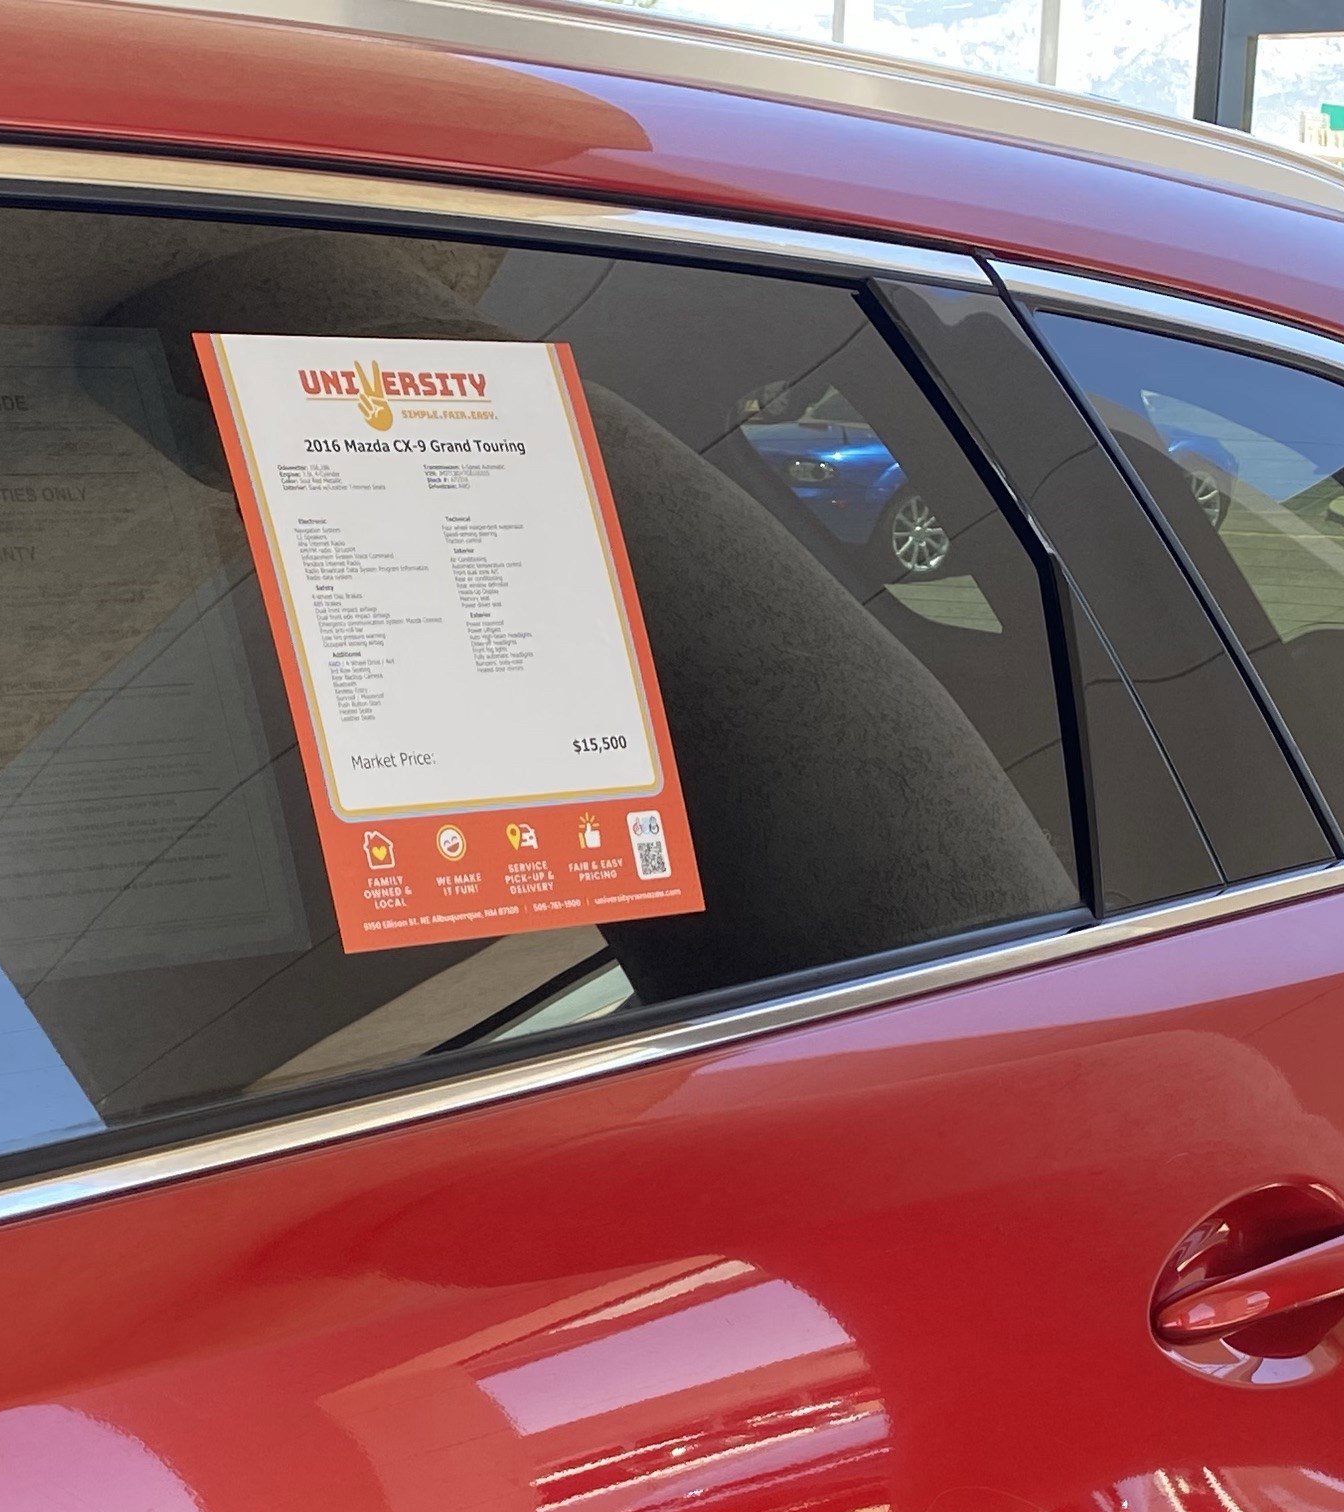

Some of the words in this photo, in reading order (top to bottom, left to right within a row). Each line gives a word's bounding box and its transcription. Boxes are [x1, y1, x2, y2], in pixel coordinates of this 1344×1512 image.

[298, 360, 487, 398] UNIVERSITY
[401, 410, 499, 421] SIMPLE.FAIR.EASY.
[304, 439, 341, 453] 2016
[344, 439, 390, 453] Mazda
[393, 439, 426, 453] CX-9
[430, 439, 471, 453] Grand
[473, 438, 526, 455] Touring
[41, 486, 88, 503] ONLY
[572, 735, 628, 754] $15,500
[350, 753, 397, 770] Market
[400, 752, 436, 767] Price:
[508, 860, 548, 873] SERVICE
[568, 861, 589, 873] FAIR
[600, 858, 623, 869] EASY
[368, 875, 403, 888] FAMILY
[436, 876, 452, 887] WE
[454, 872, 482, 884] MAKE
[505, 871, 545, 884] PICK-UP
[579, 870, 618, 882] PRICING
[363, 887, 402, 899] OWNED
[443, 886, 452, 896] IT
[455, 884, 479, 895] FUN!
[509, 882, 554, 894] DELIVERY
[374, 897, 407, 910] LOCAL
